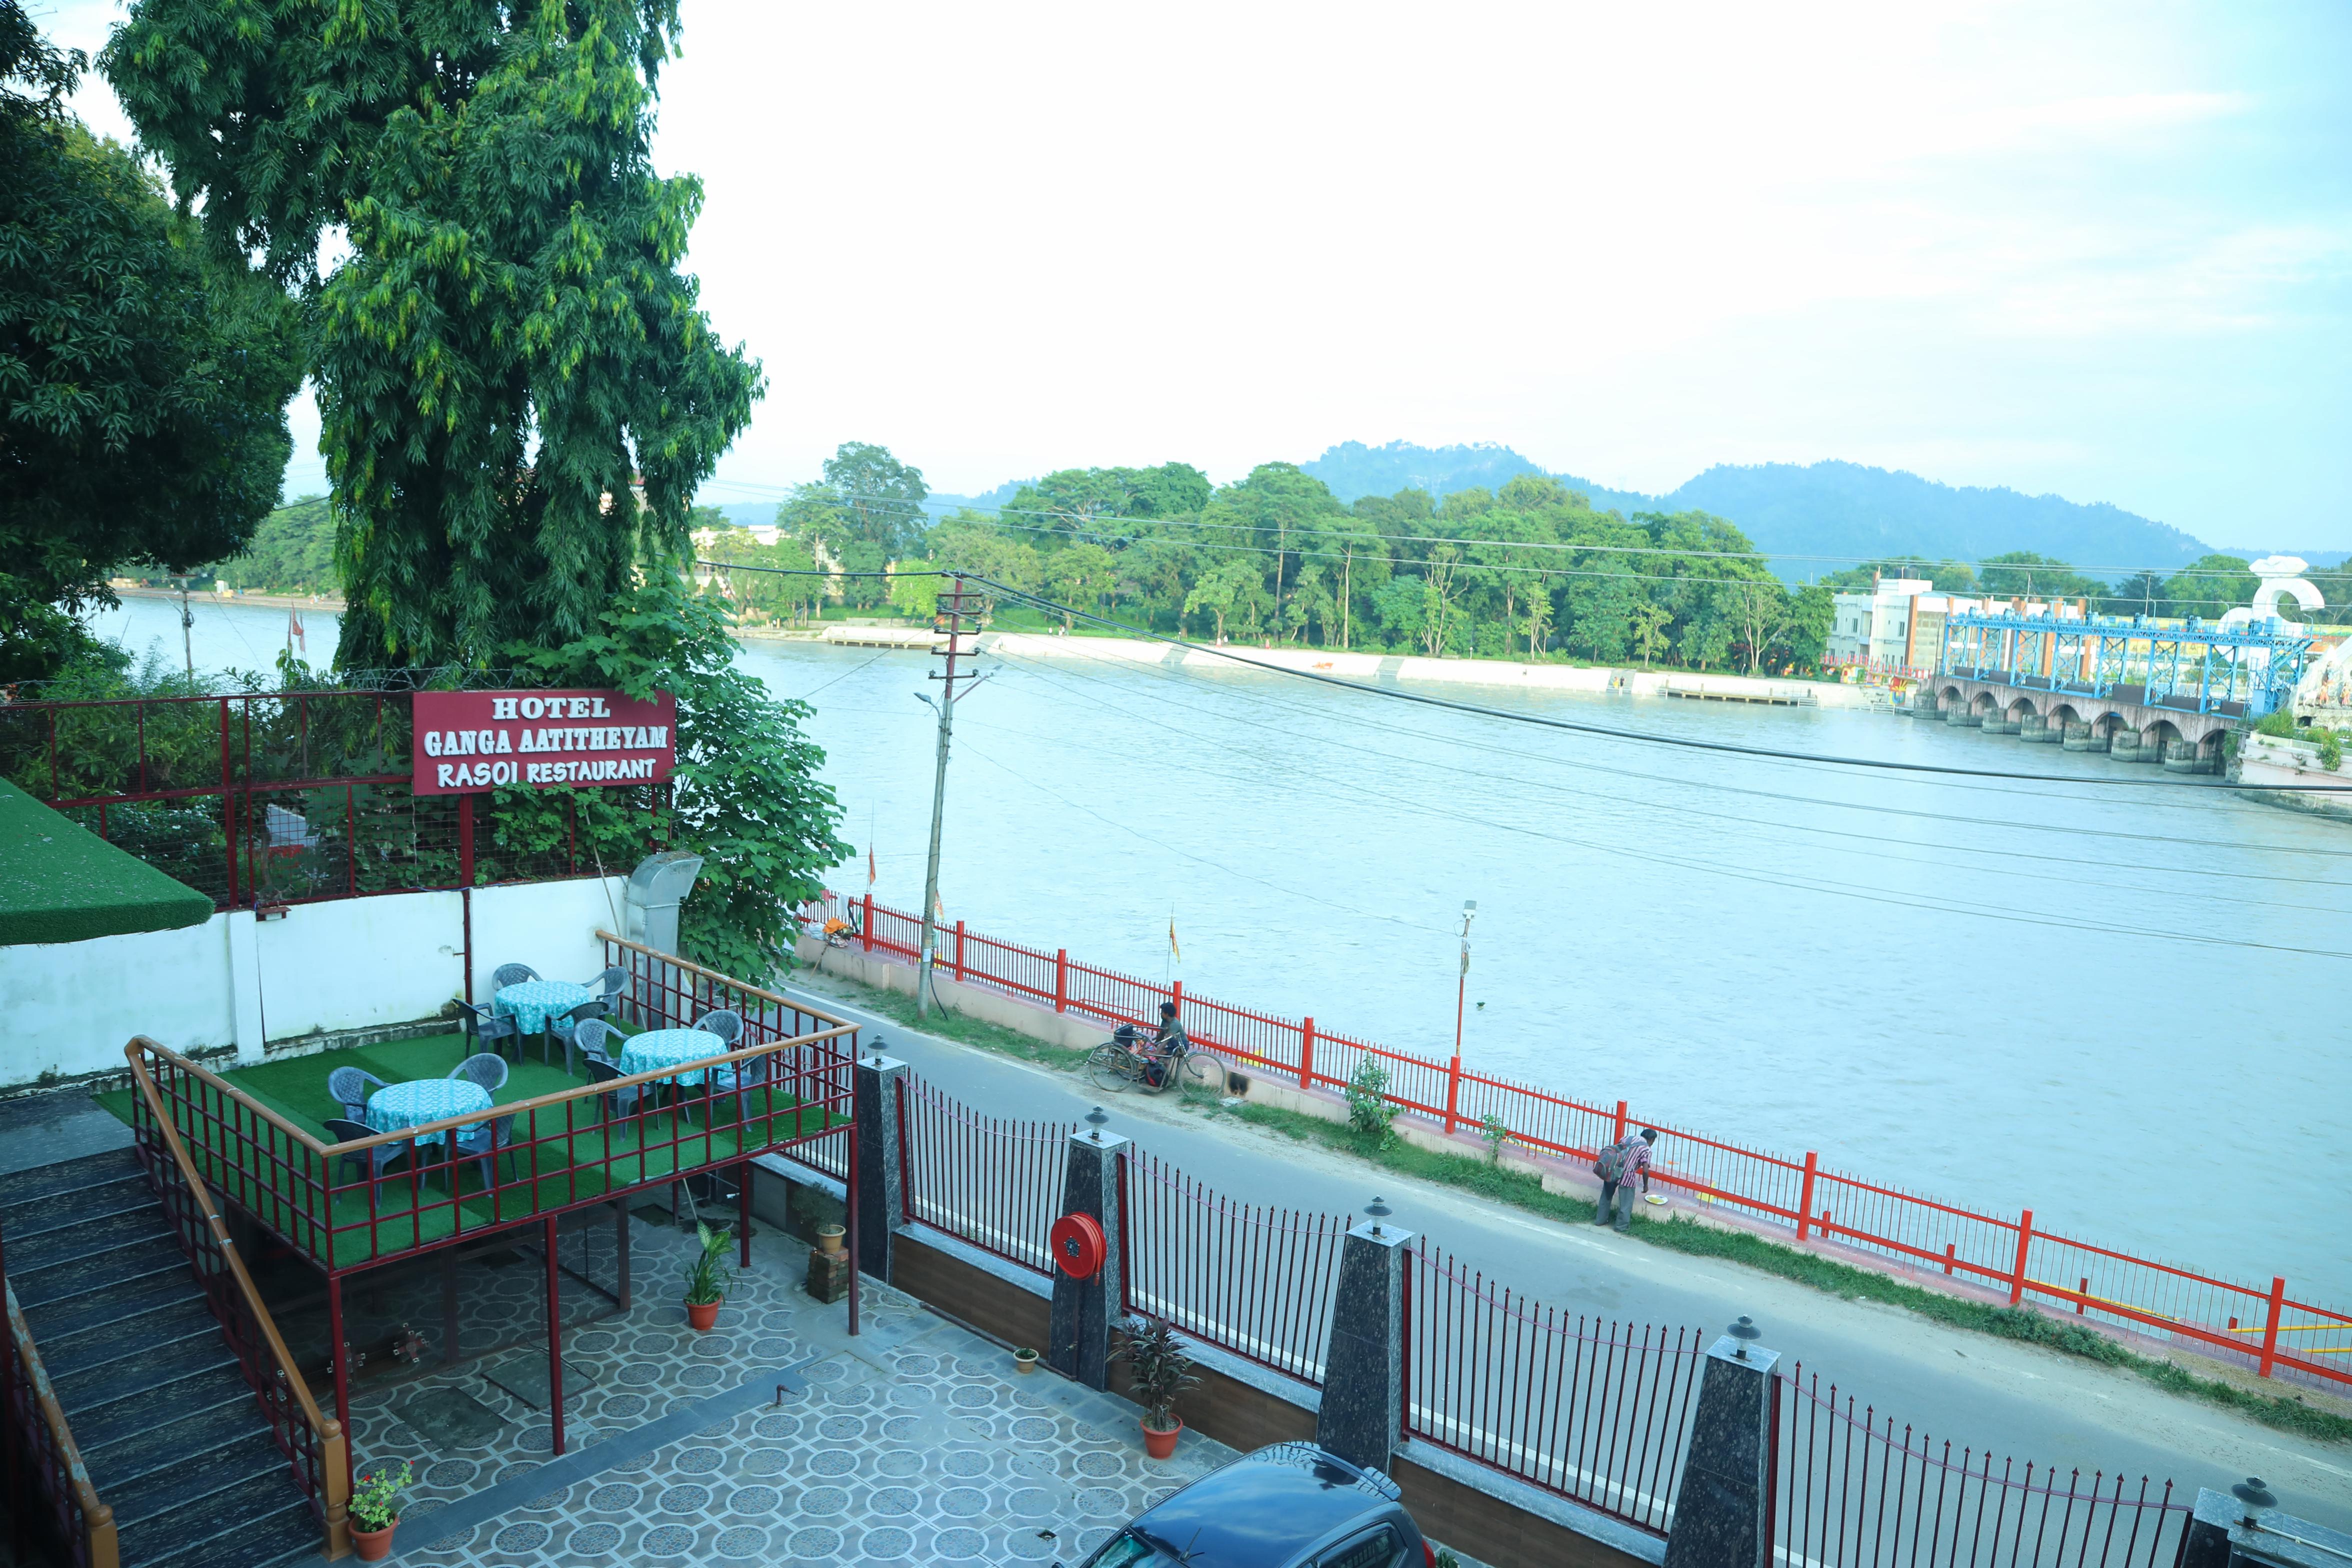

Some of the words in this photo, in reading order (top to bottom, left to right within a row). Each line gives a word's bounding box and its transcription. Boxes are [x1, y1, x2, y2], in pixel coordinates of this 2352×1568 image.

[492, 697, 611, 720] HOTEL
[424, 730, 512, 757] GANGA
[518, 726, 668, 753] AATITHEYAM
[437, 761, 518, 788] RASOI
[526, 758, 657, 784] RESTAURANT
